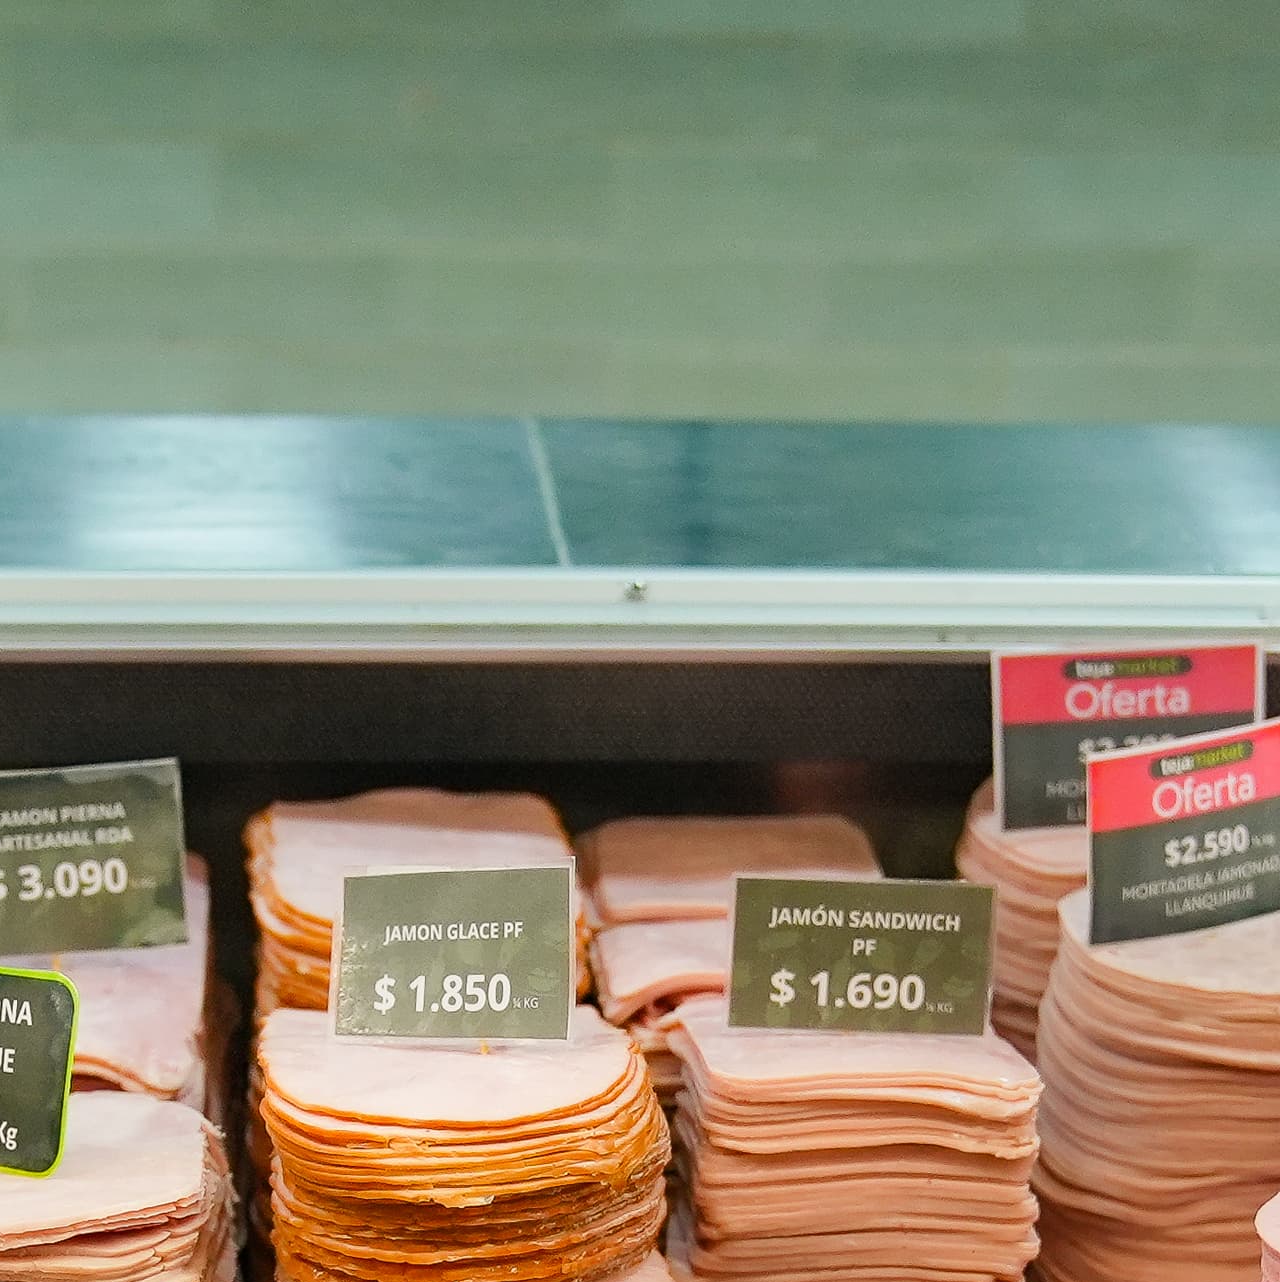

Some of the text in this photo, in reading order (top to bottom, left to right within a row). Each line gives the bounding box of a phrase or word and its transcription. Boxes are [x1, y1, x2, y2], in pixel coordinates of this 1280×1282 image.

[1065, 681, 1191, 718] Oferta
[60, 800, 126, 823] PIERNA
[1152, 772, 1257, 818] Oferta
[1164, 824, 1251, 868] $2.590
[17, 857, 129, 901] 3.090
[768, 903, 961, 933] JAMÓN SANDWICH
[1165, 884, 1256, 917] LLANQUIHUE
[383, 921, 524, 946] JAMON GLACE PF
[852, 937, 878, 957] PF
[373, 973, 396, 1016] $
[409, 973, 511, 1012] 1.850
[523, 996, 539, 1009] KG
[769, 967, 797, 1007] $
[810, 969, 926, 1012] 1.690
